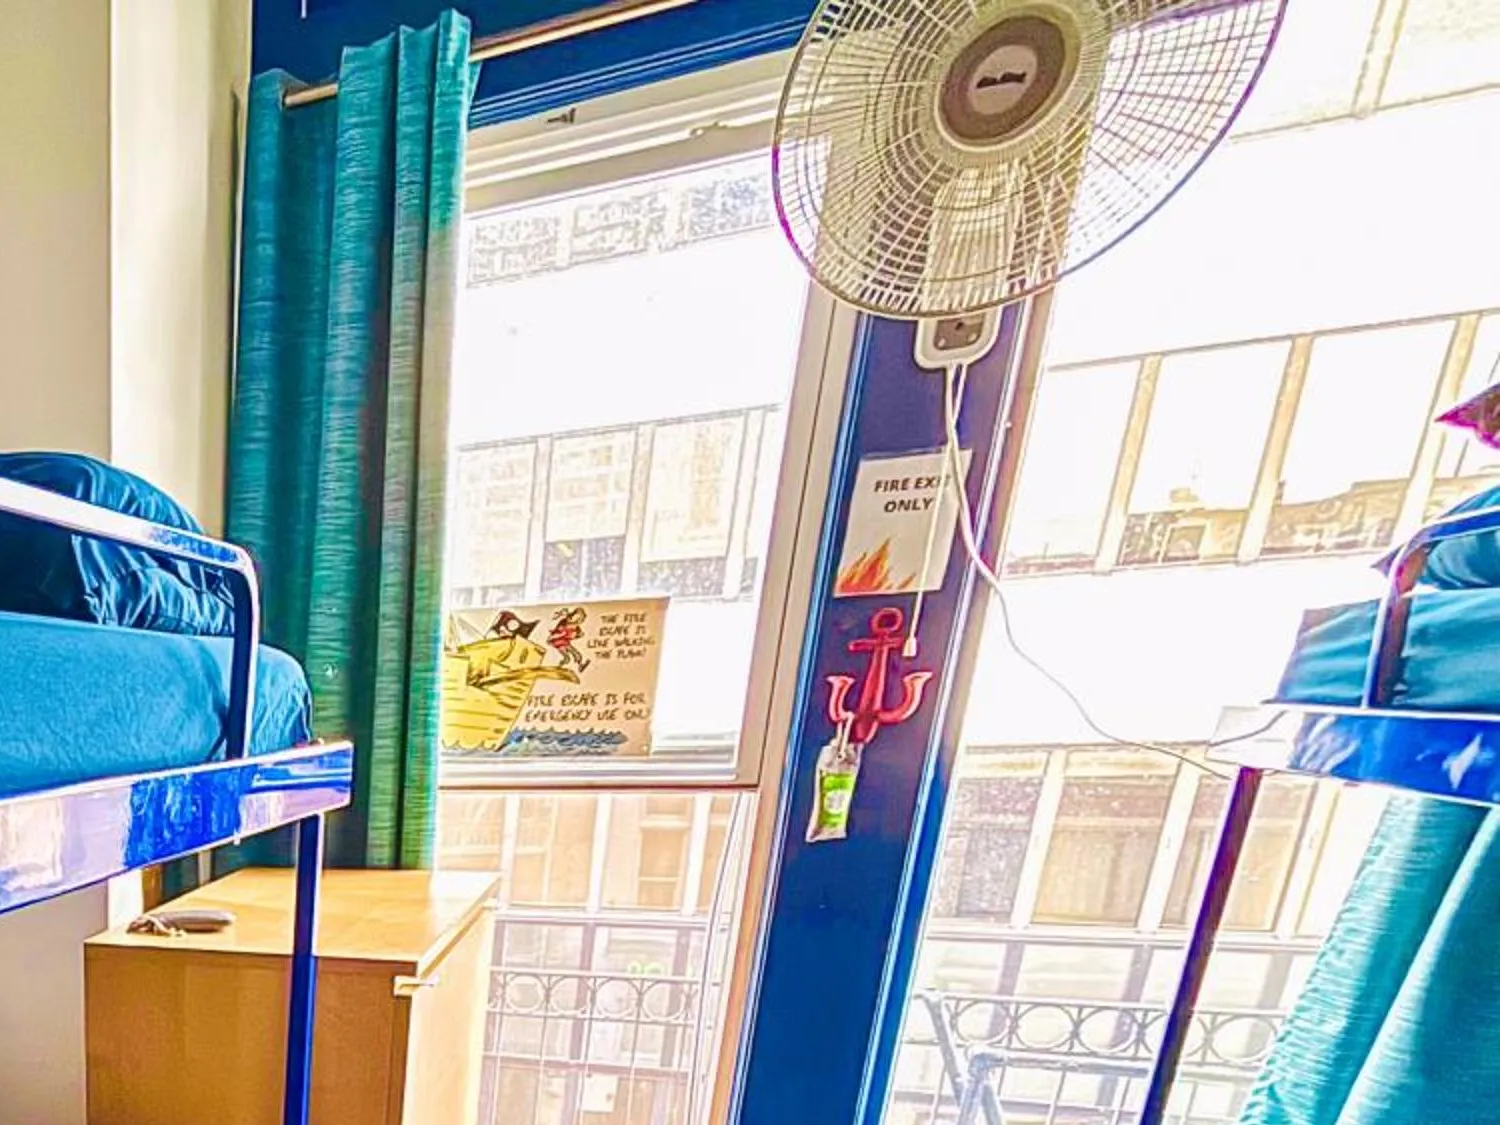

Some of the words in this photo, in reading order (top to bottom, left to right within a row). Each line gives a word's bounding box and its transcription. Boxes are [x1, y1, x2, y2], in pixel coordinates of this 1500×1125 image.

[874, 477, 910, 493] FIRE
[884, 498, 933, 513] ONLY
[623, 691, 646, 705] FOR
